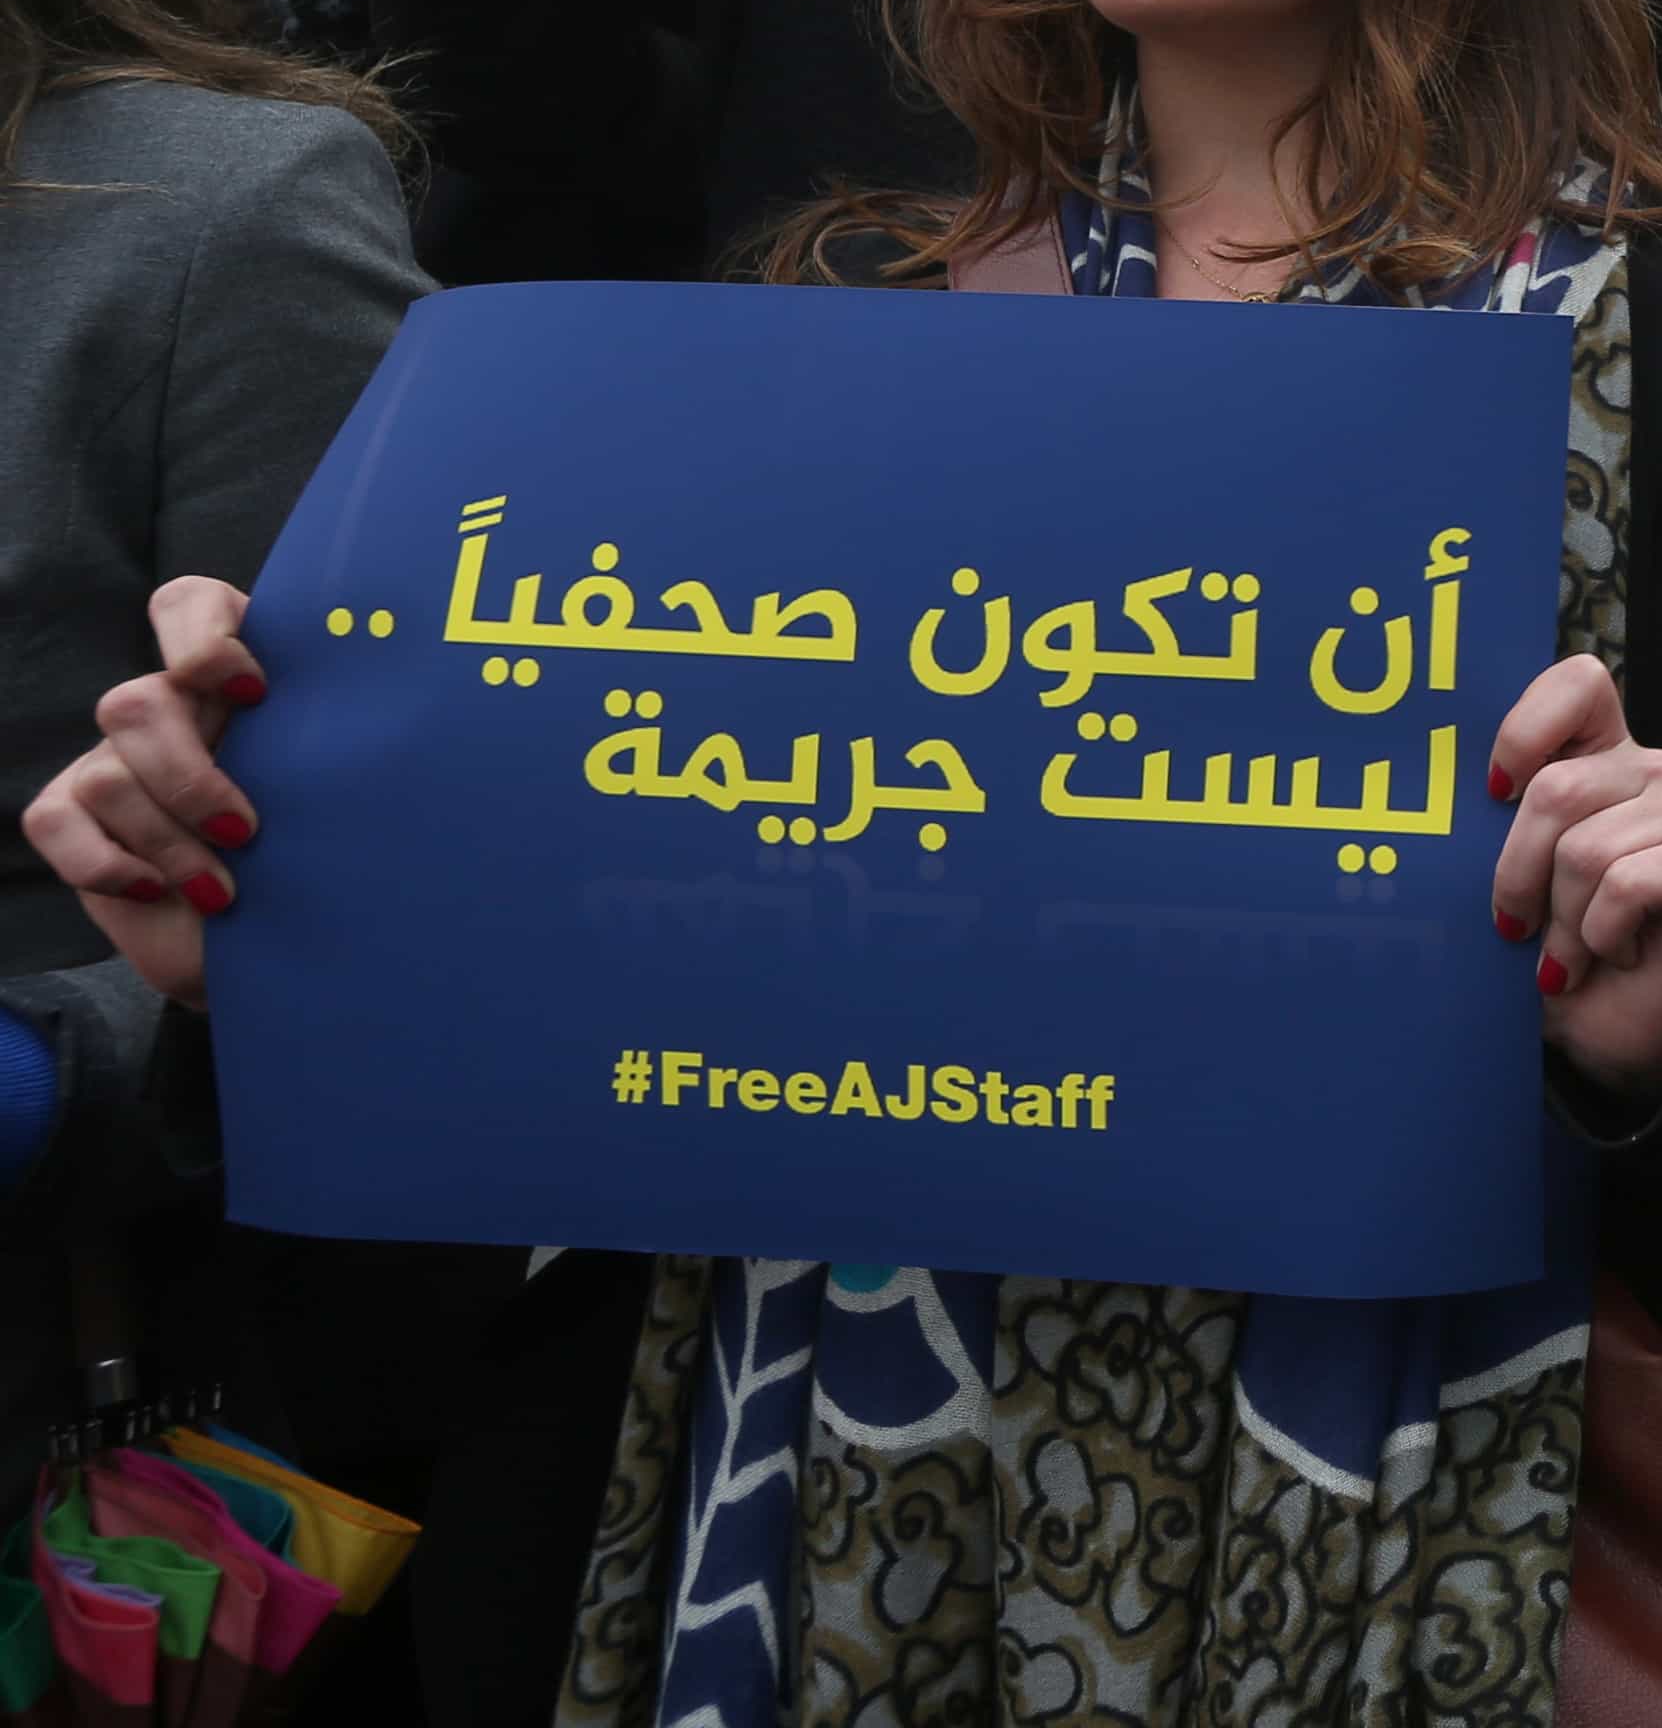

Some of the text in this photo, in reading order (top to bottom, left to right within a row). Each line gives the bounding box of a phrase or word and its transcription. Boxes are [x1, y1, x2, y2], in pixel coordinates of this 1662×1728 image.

[445, 497, 857, 686] صحفياً
[910, 568, 1260, 707] تكون
[1310, 528, 1471, 714] أن
[585, 689, 1457, 874] ليست جريمة
[613, 1051, 1115, 1129] #FreeAJStaff
